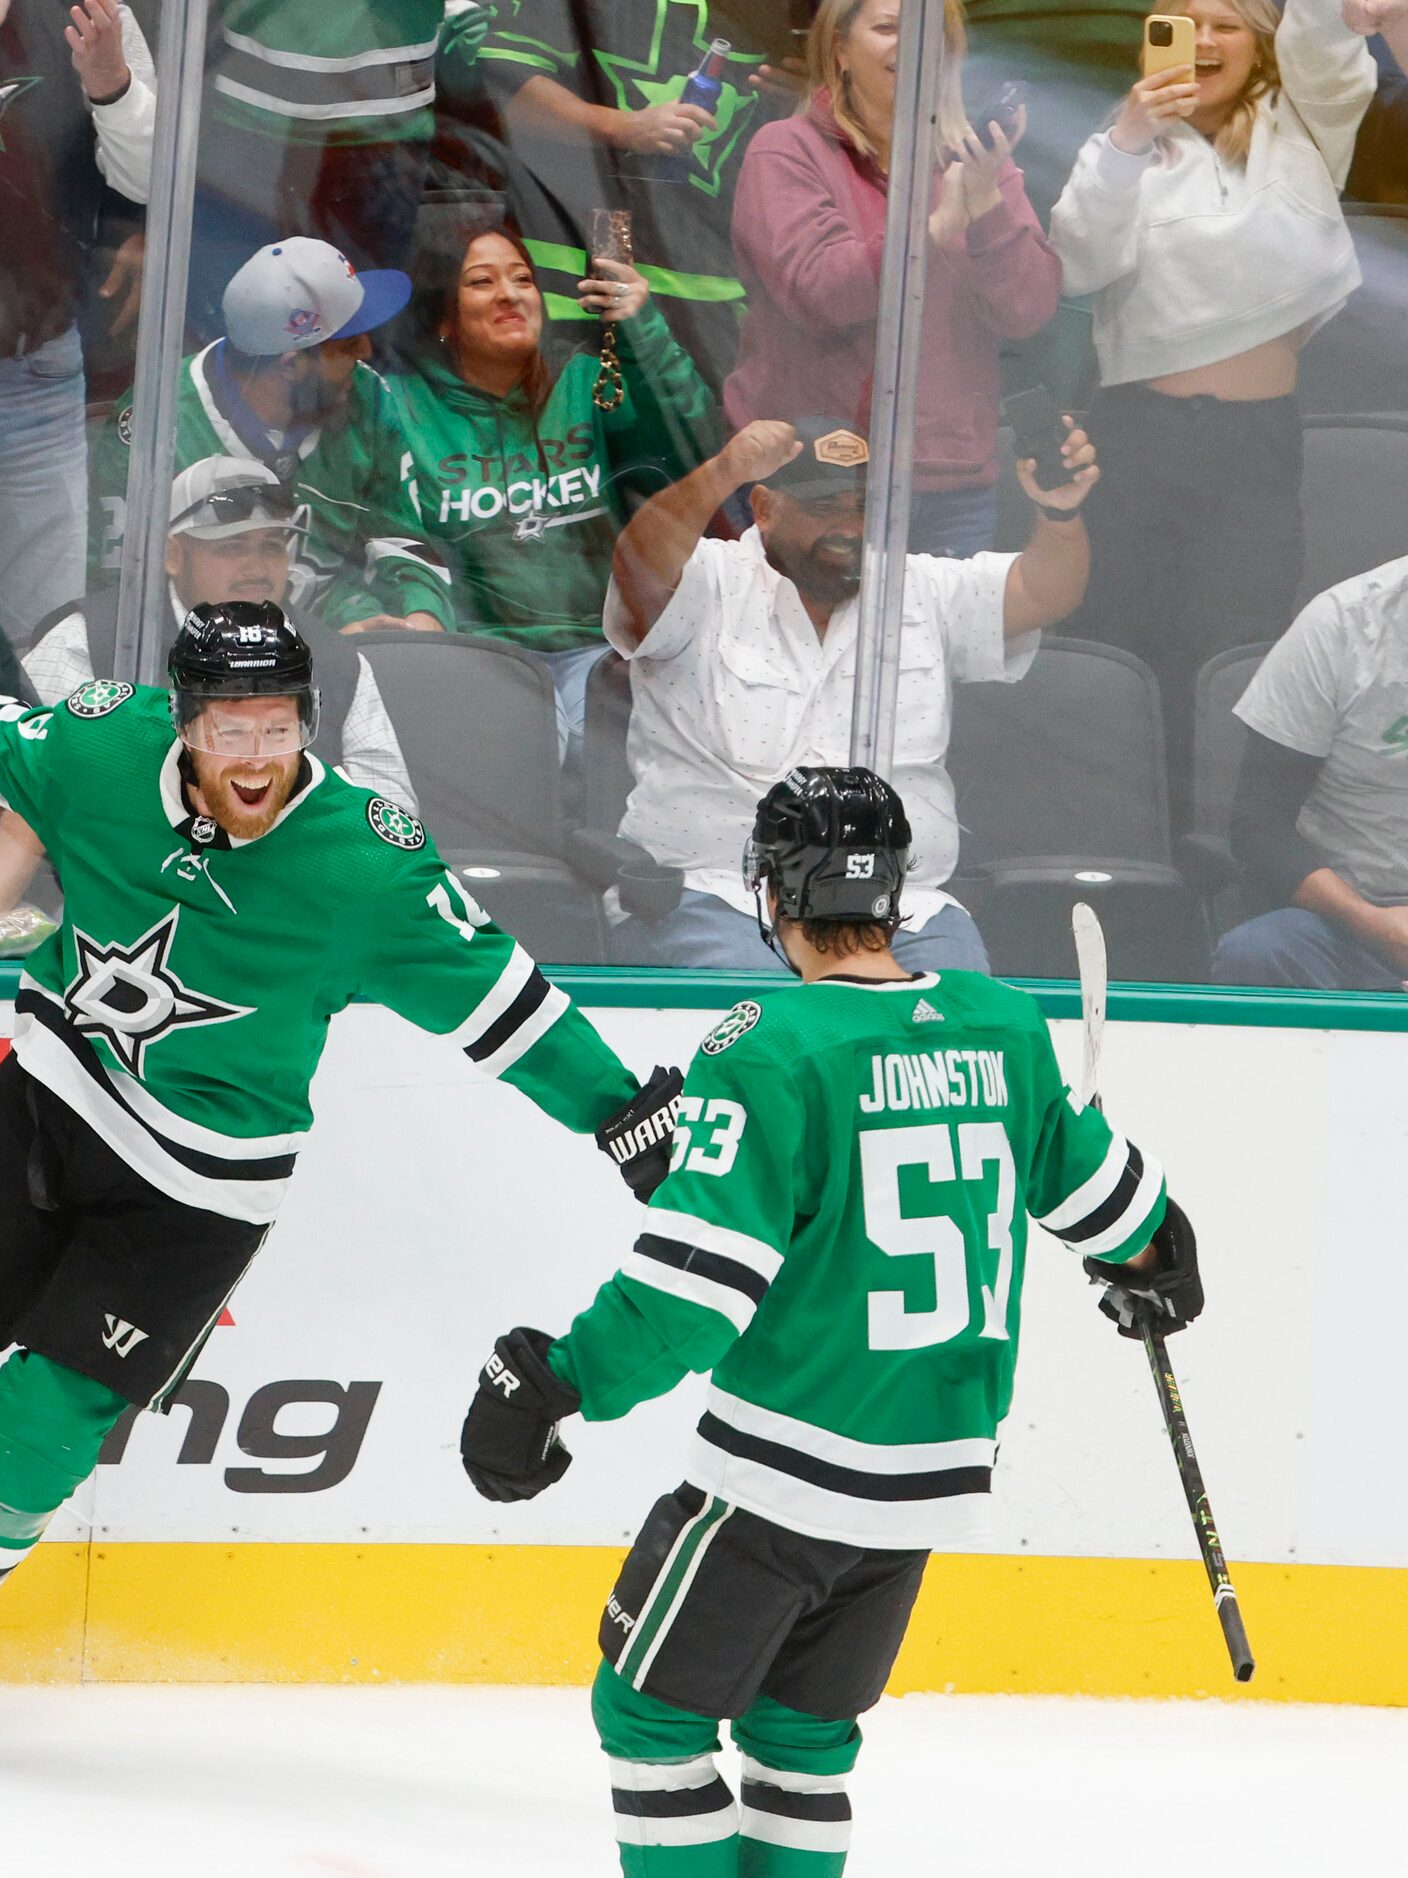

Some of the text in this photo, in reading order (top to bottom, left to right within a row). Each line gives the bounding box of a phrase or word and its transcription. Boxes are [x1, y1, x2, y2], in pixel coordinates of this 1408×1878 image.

[439, 423, 593, 485] STARS
[440, 464, 600, 522] HOCKEY
[229, 658, 276, 669] WARRIOR
[845, 853, 875, 879] 53
[859, 1050, 1008, 1113] JOHNSTON
[858, 1122, 1016, 1351] 53
